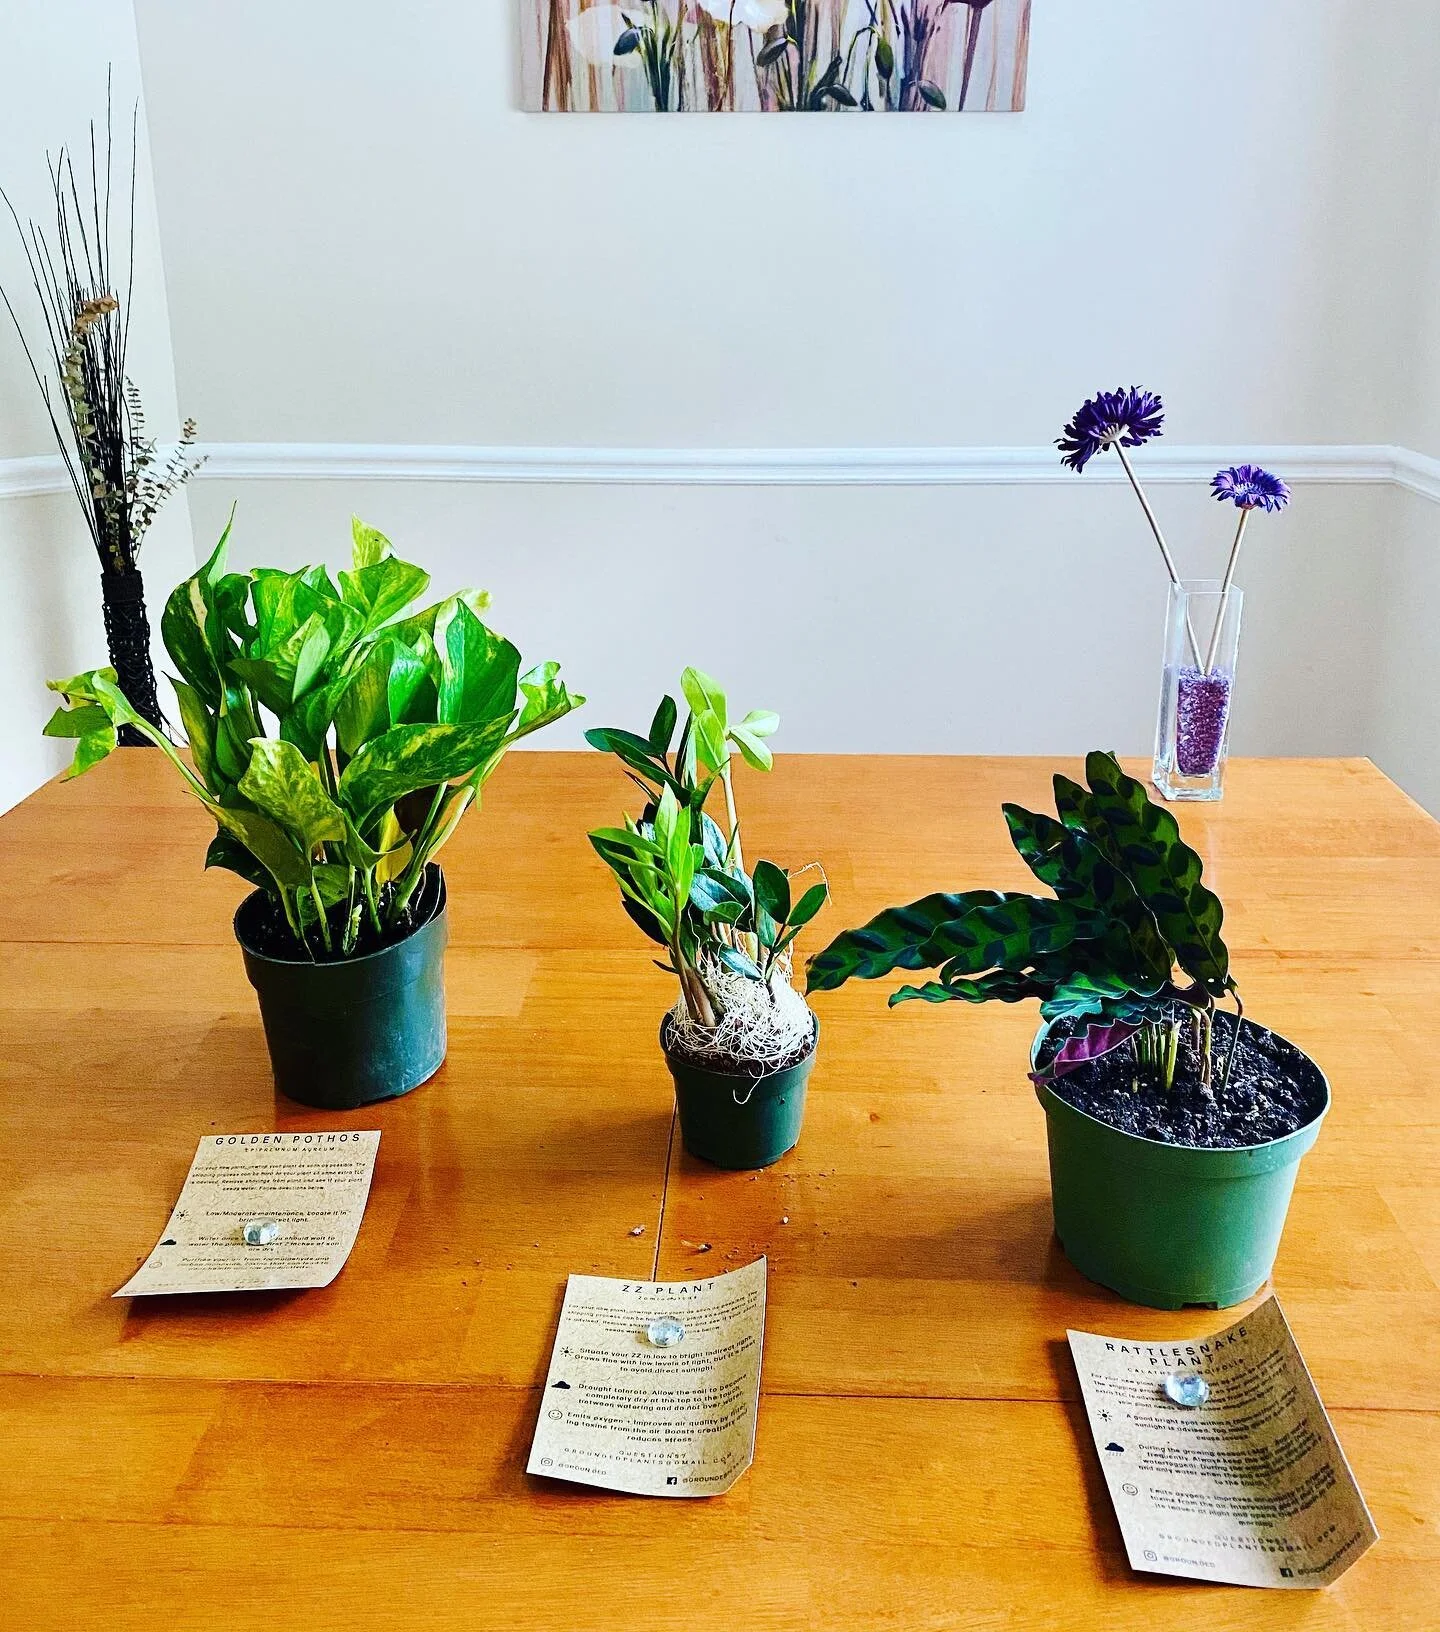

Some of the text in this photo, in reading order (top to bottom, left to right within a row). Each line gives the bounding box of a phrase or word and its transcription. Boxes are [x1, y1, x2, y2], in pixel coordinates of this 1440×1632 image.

[215, 1133, 361, 1145] GOLDEN POTHOS
[621, 1282, 715, 1294] ZZ PLANT
[1105, 1326, 1248, 1357] RATTLESNAKE
[1149, 1353, 1213, 1367] PLANT
